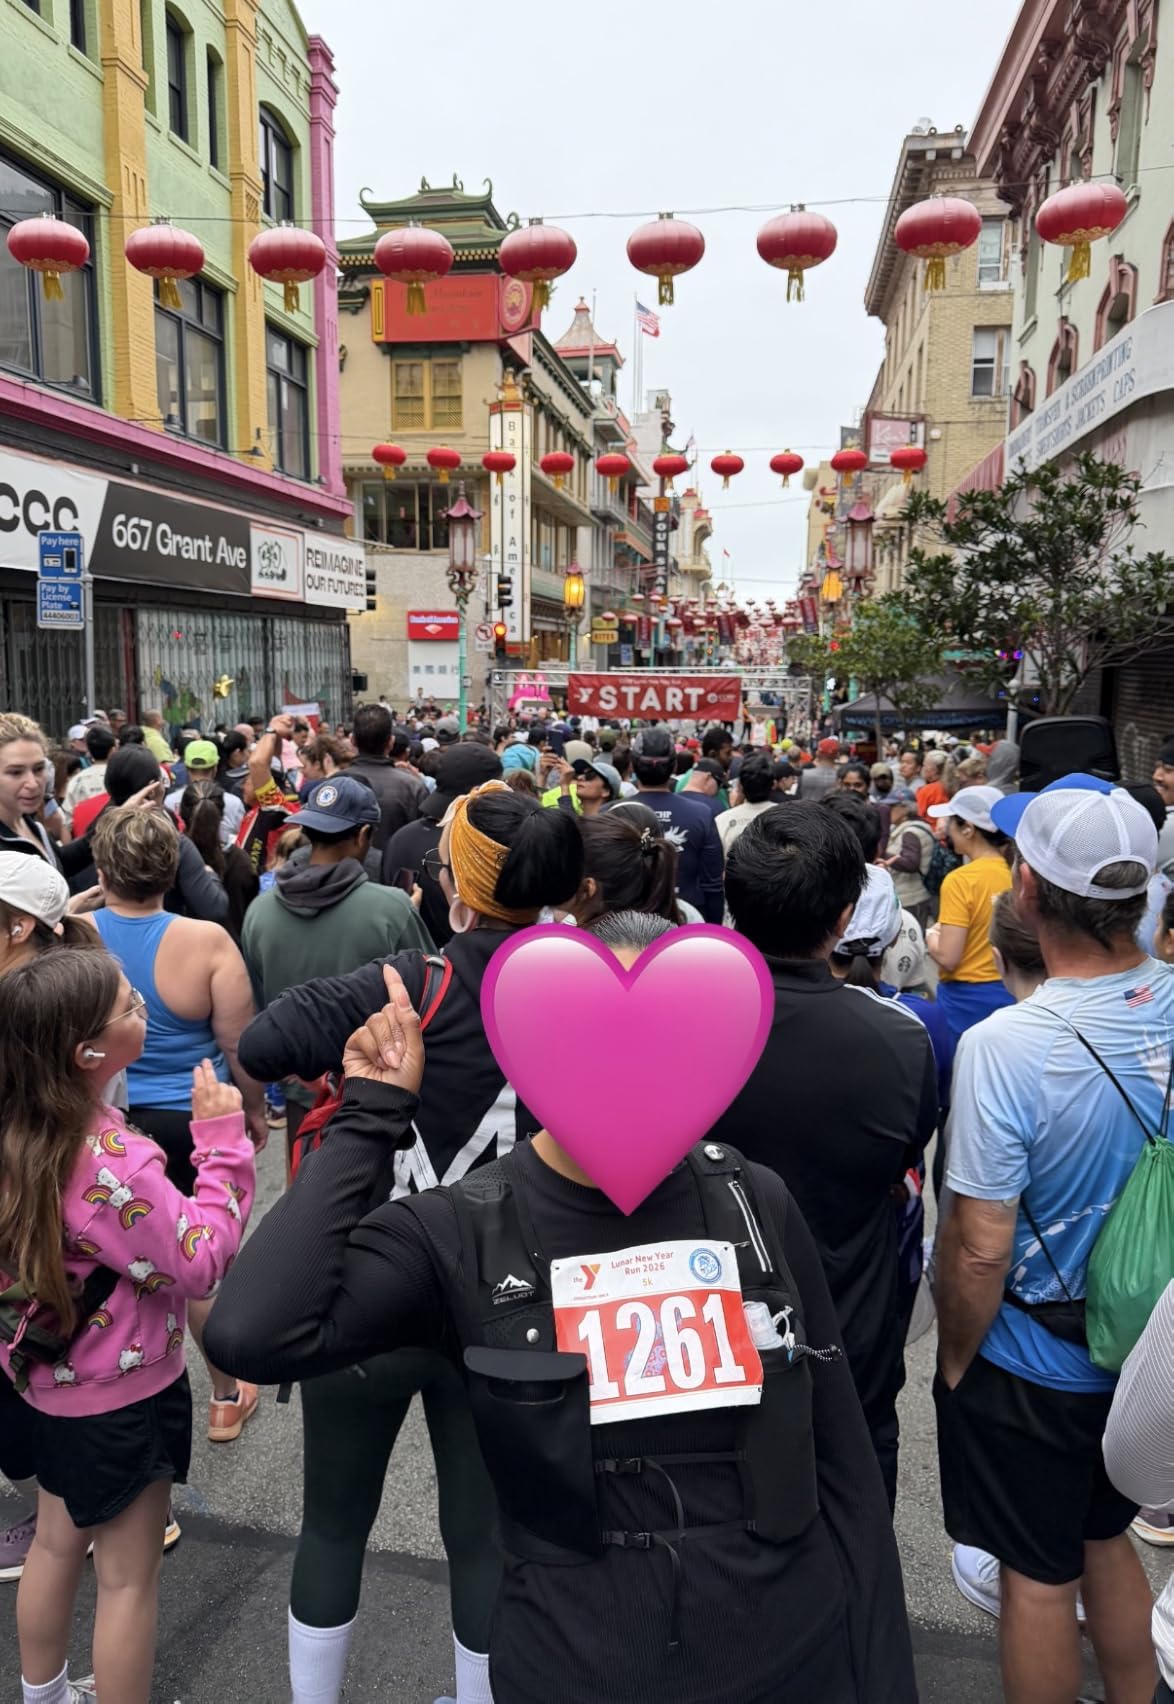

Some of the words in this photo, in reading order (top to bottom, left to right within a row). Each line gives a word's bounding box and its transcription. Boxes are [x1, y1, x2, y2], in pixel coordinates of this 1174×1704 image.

[1113, 368, 1136, 403] CAPS
[508, 421, 516, 478] Bak
[0, 482, 80, 537] CCC
[509, 494, 516, 519] of
[41, 536, 58, 548] Pay
[59, 536, 80, 546] here
[112, 513, 153, 552] 667
[155, 522, 213, 563] Grant
[215, 536, 247, 569] Ave
[655, 512, 667, 551] FOUR
[306, 547, 364, 577] REIMAGINE
[41, 583, 57, 595] Pay
[60, 583, 70, 594] by
[306, 573, 328, 593] OUR
[508, 536, 517, 633] Ameca
[41, 592, 72, 602] License
[41, 601, 63, 610] Plate
[598, 685, 705, 712] START
[611, 1258, 633, 1269] Lunar
[635, 1255, 653, 1264] New
[654, 1251, 674, 1260] Year
[624, 1265, 641, 1275] Run
[643, 1262, 665, 1273] 2026
[642, 1278, 654, 1287] 5k
[578, 1293, 747, 1402] 1261
